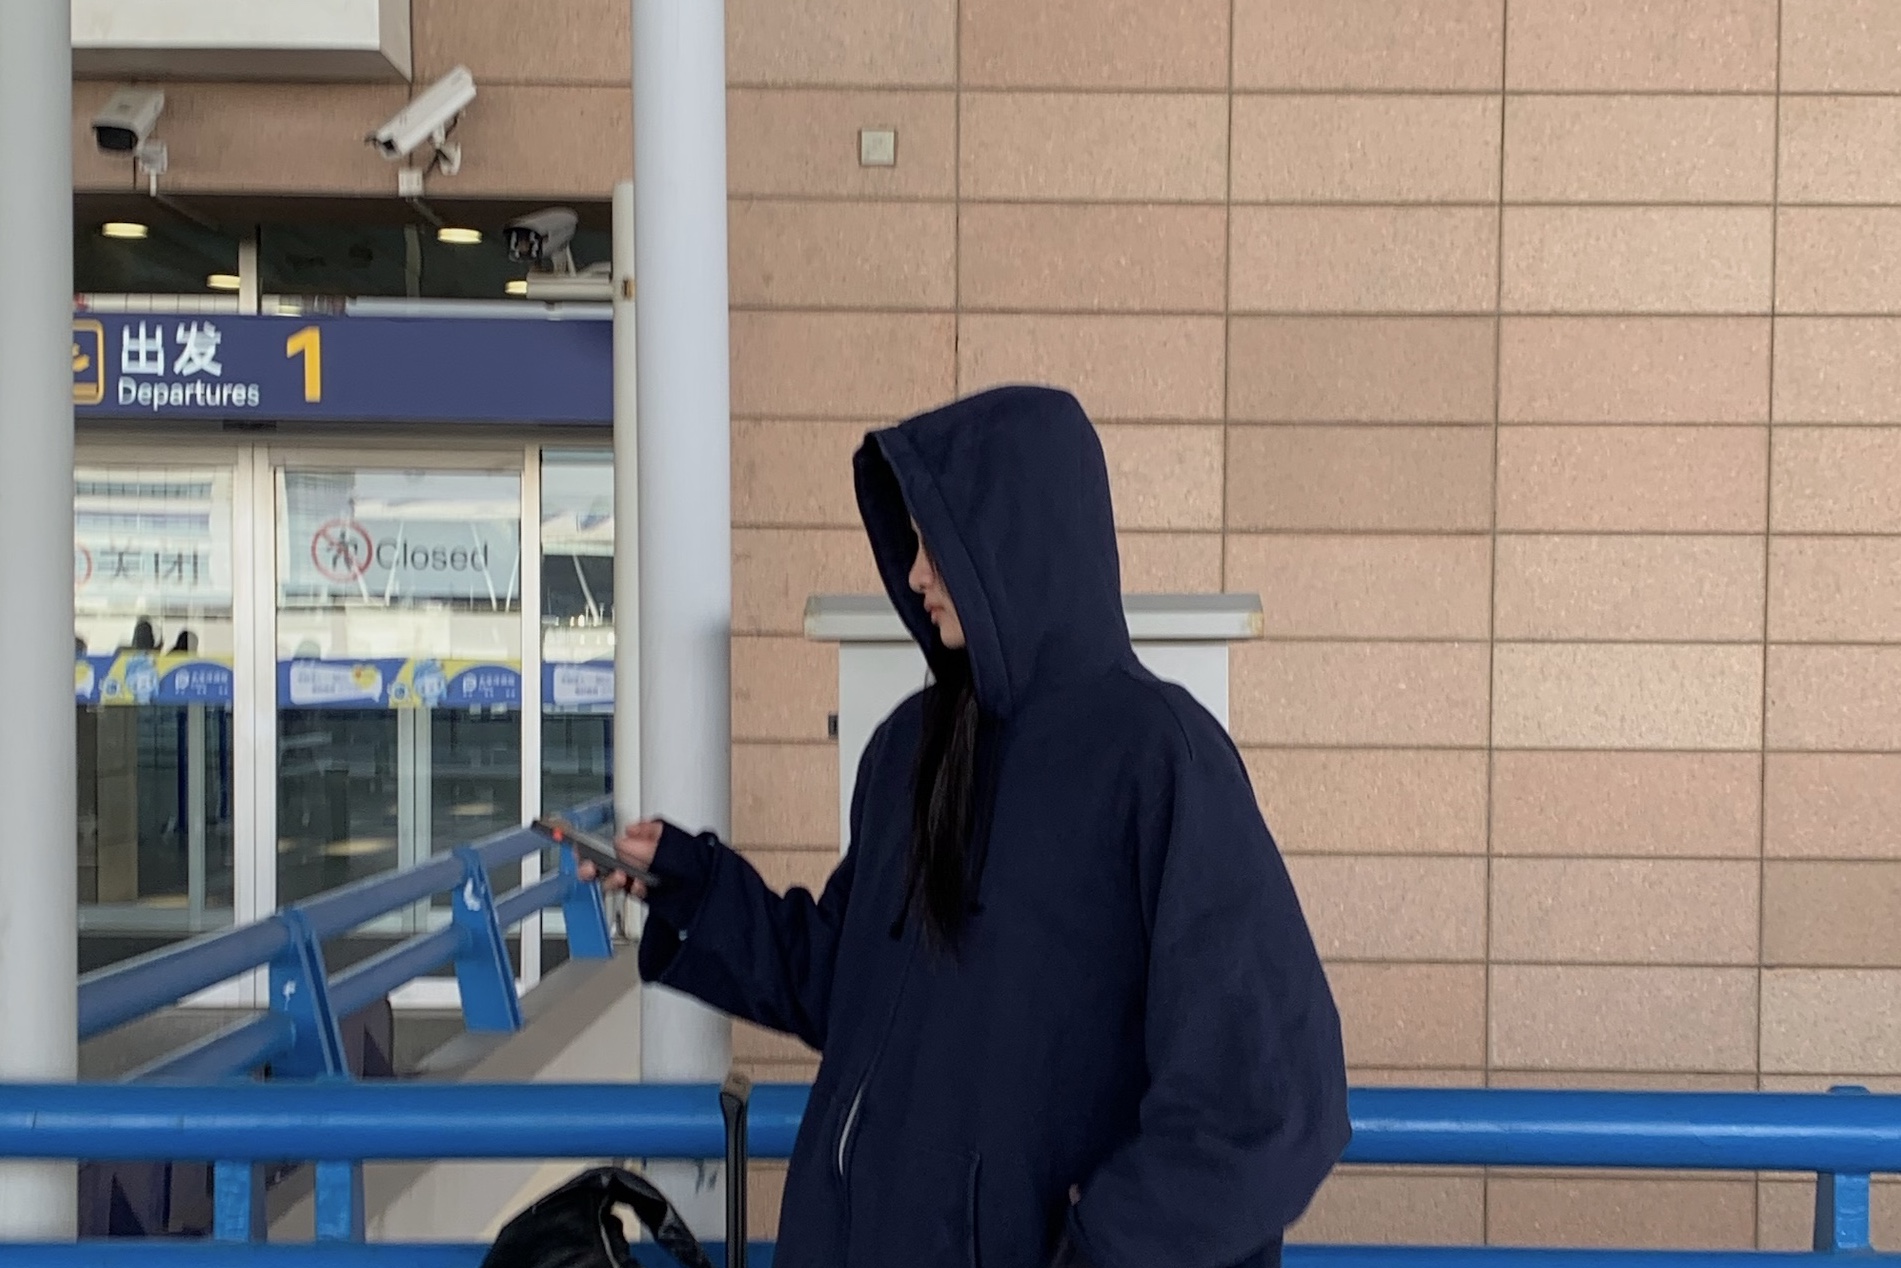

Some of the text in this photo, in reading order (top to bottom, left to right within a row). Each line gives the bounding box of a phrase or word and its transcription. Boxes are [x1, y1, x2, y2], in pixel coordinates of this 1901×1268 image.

[121, 320, 222, 377] 出发
[286, 325, 321, 403] 1
[117, 376, 260, 412] Departures
[376, 538, 489, 572] Closed
